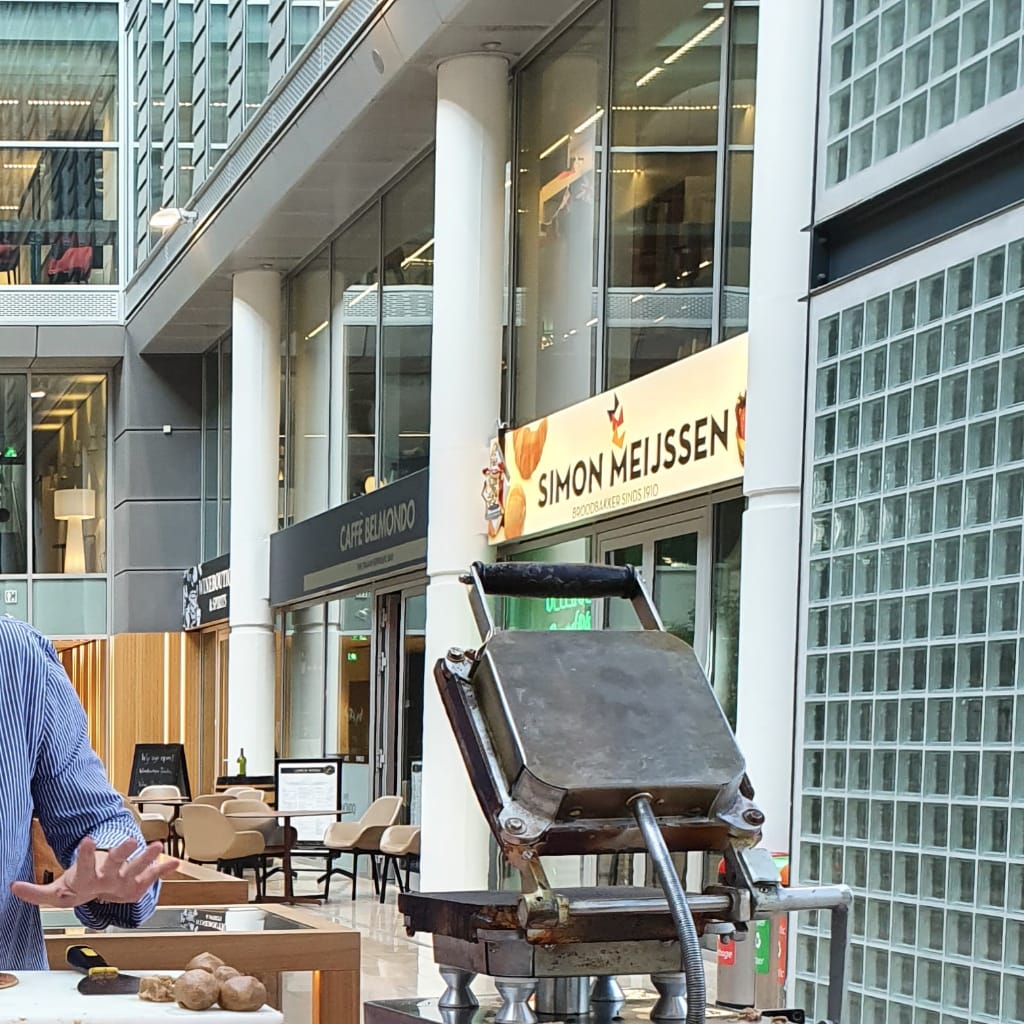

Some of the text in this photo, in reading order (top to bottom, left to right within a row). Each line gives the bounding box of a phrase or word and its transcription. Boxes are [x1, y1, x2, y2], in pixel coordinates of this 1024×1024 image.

[538, 453, 603, 508] SIMON
[610, 409, 729, 487] MEIJSSEN
[339, 499, 416, 552] CAFFÈ BELMONDO
[572, 483, 659, 519] BROODBAKKER SINDS 1910
